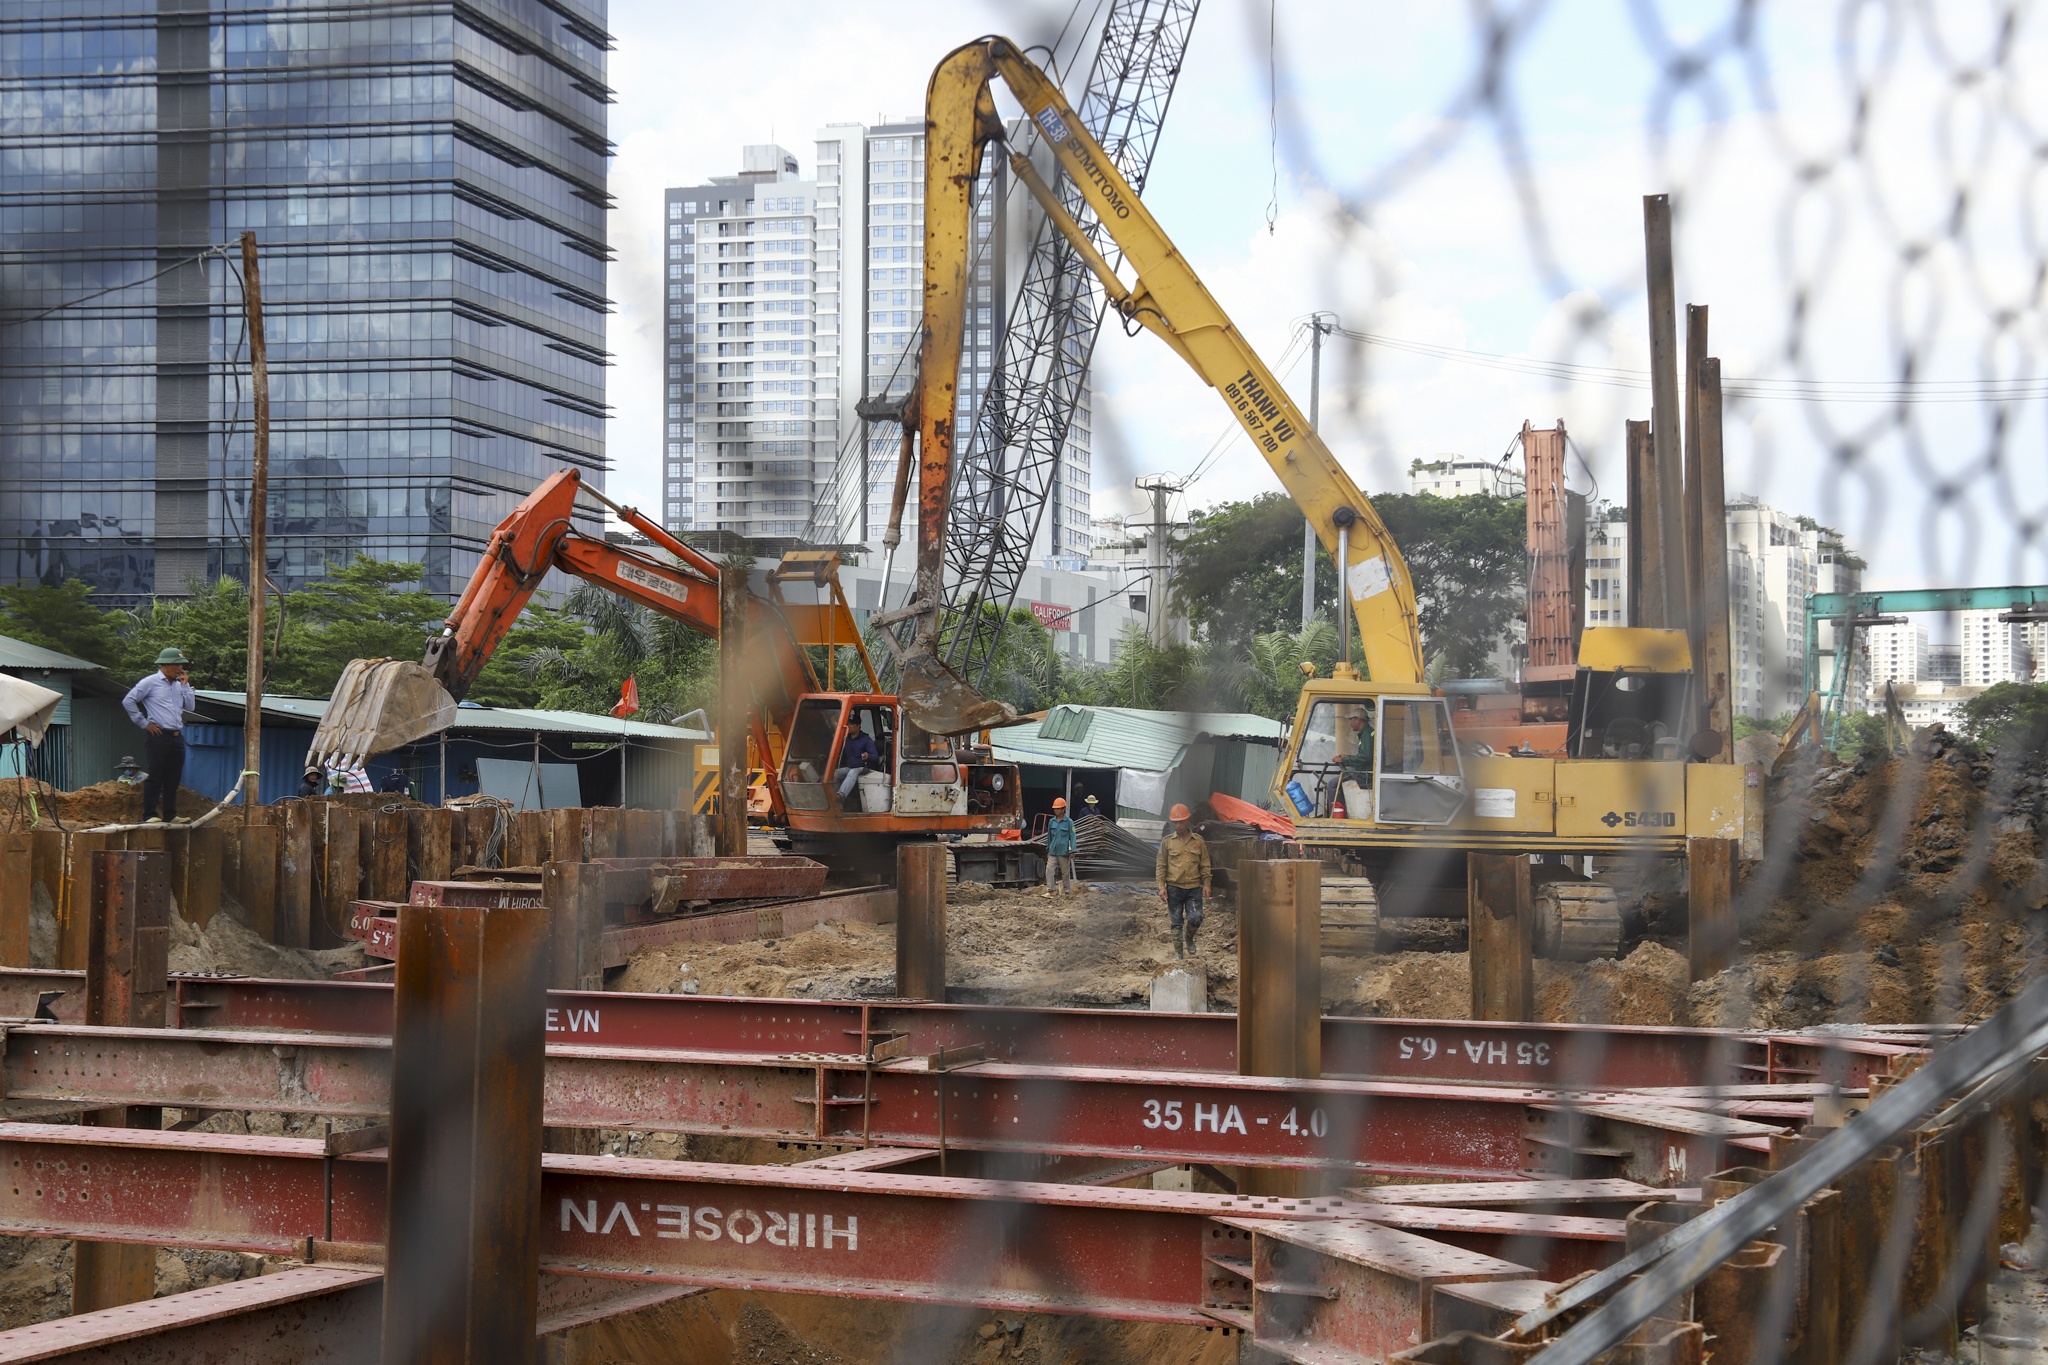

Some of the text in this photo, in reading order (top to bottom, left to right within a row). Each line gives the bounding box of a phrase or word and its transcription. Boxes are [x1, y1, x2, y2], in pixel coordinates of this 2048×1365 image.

[1039, 107, 1068, 142] TH-38
[1067, 137, 1130, 219] SUMITOMO
[1225, 383, 1279, 453] 0916 567 700
[1238, 369, 1297, 443] THANH VŨ
[1034, 605, 1070, 621] CALIFORNIA
[1624, 811, 1676, 827] S430
[351, 915, 370, 931] 6.0
[372, 930, 394, 946] 4.5
[1399, 1036, 1438, 1061] 6.5
[1464, 1040, 1508, 1065] HA
[1517, 1041, 1551, 1066] 35
[1142, 1099, 1183, 1131] 35
[1194, 1102, 1248, 1135] HA
[1280, 1106, 1329, 1138] 4.0
[561, 1198, 859, 1252] HIROSE.VN
